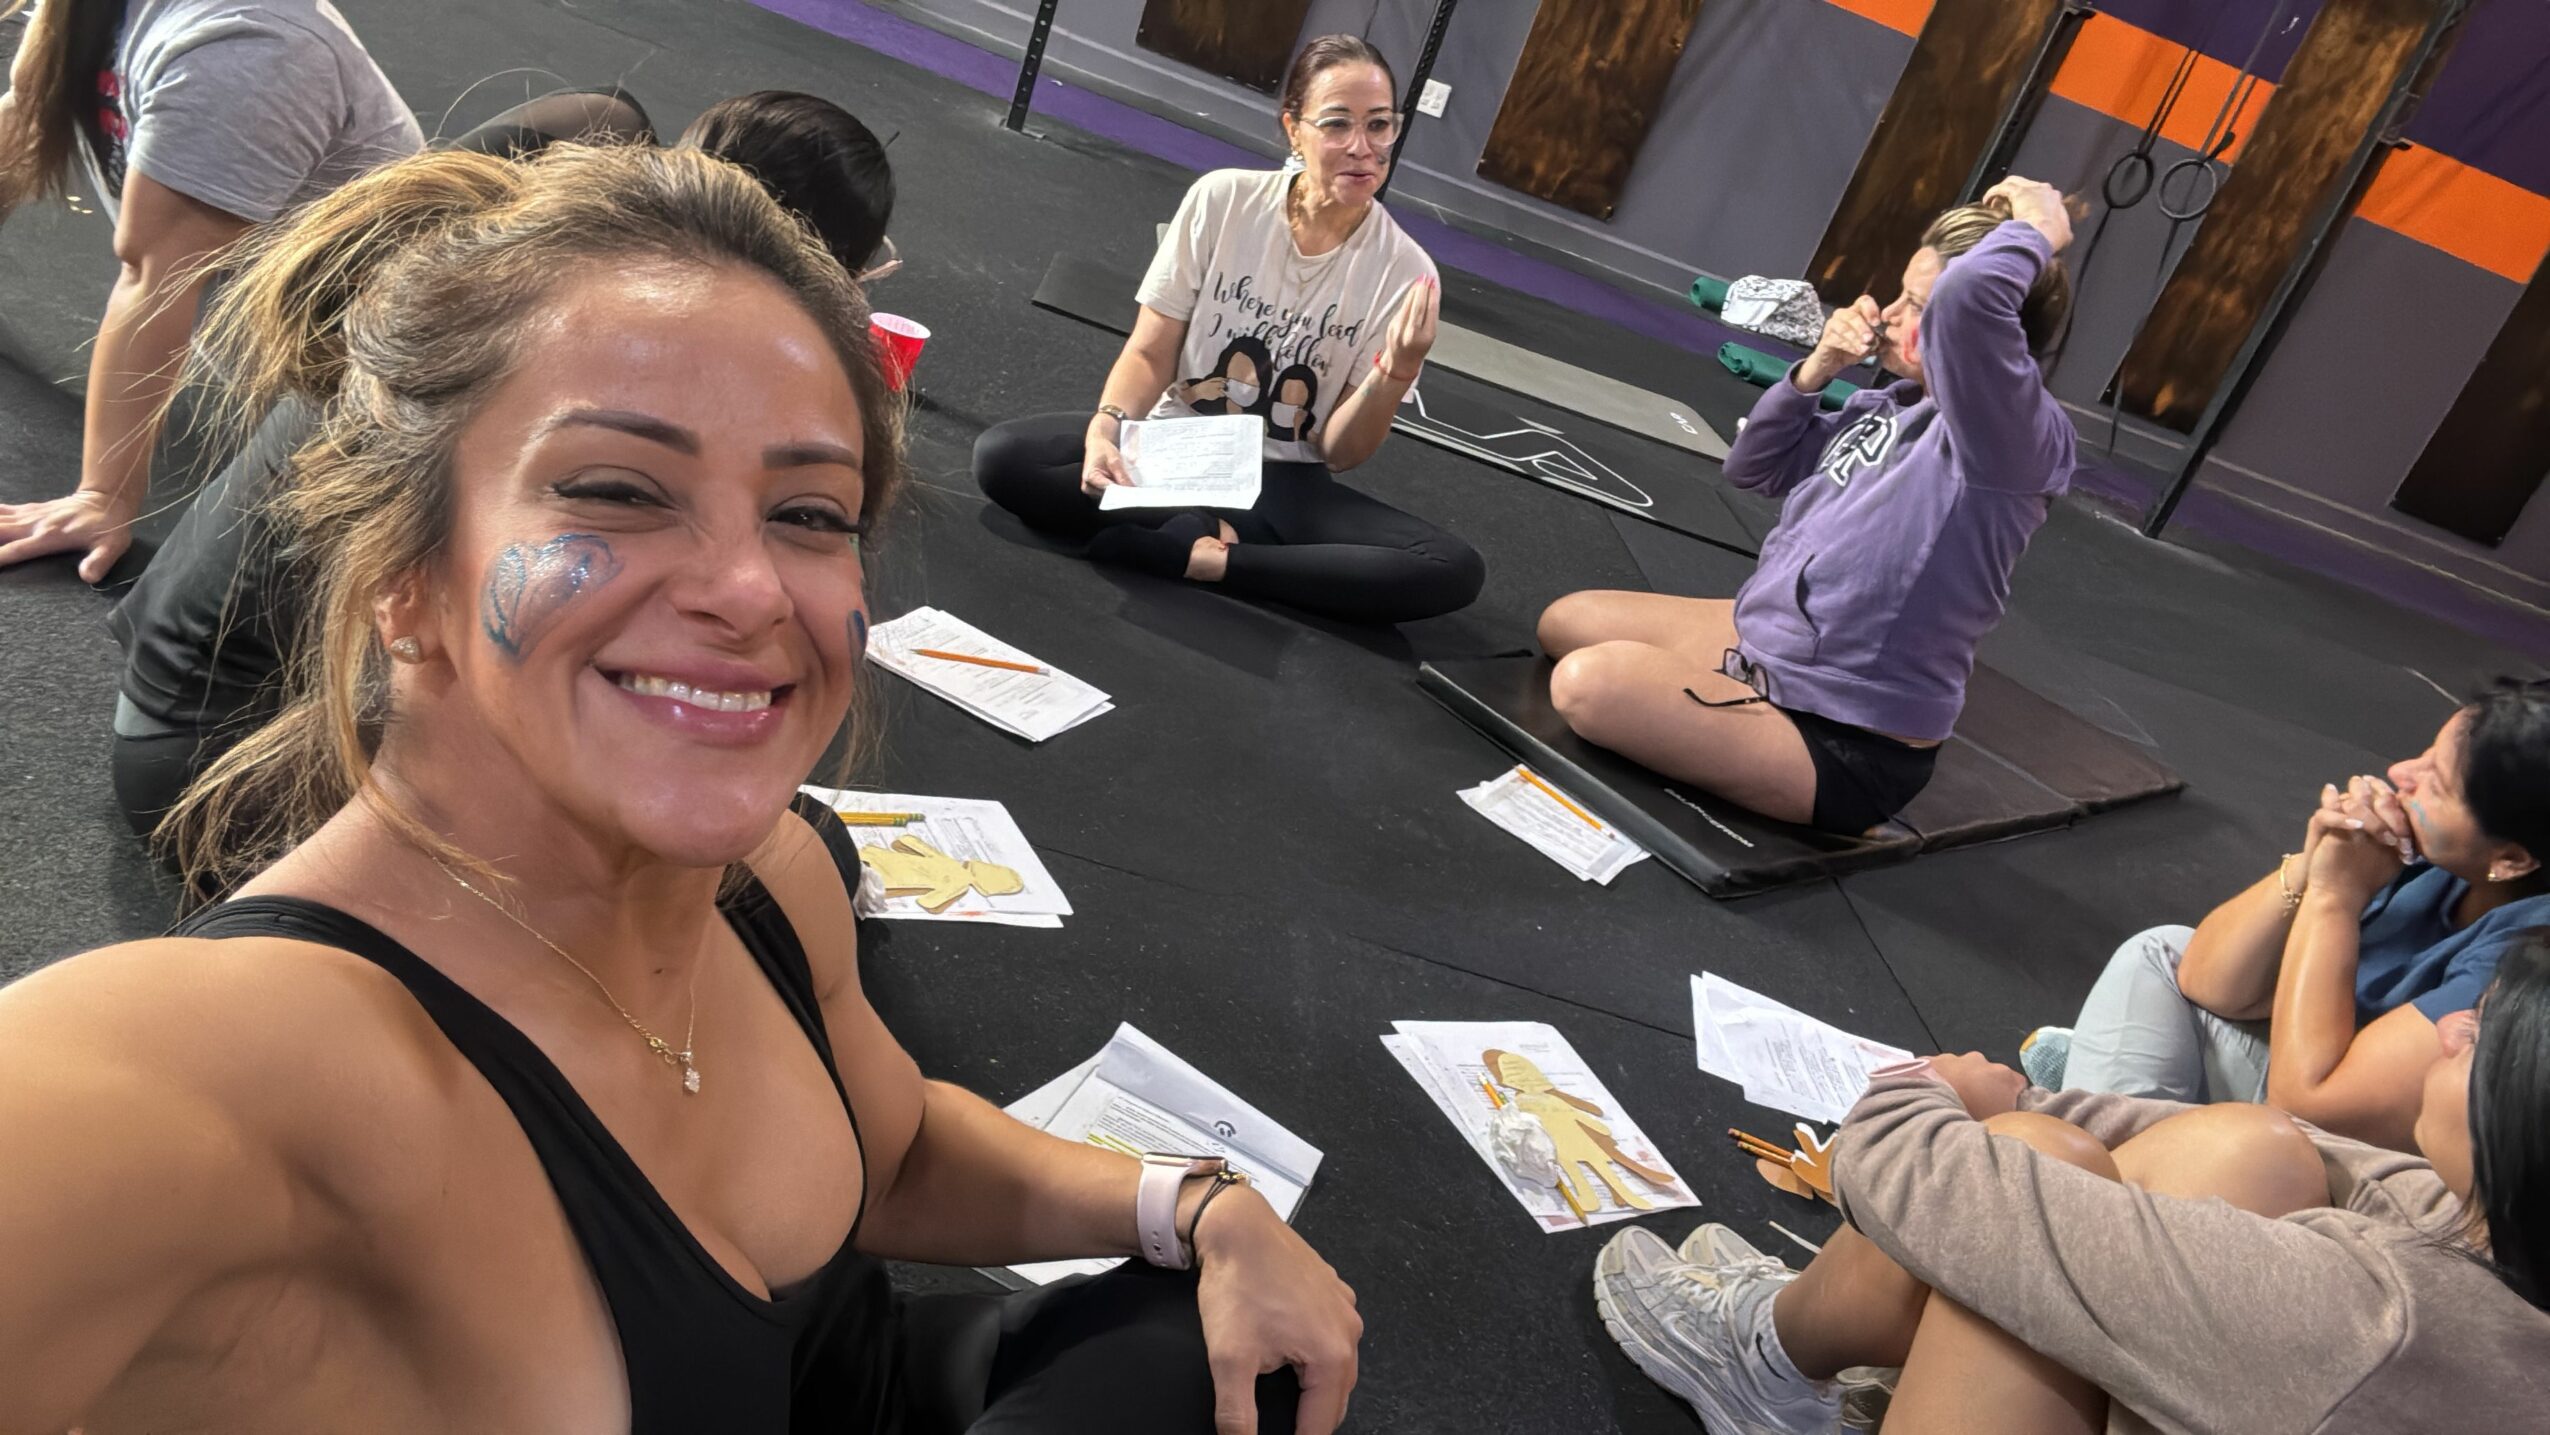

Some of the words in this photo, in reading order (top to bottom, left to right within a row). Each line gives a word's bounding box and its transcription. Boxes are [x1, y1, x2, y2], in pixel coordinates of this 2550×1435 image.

[1208, 312, 1223, 338] I
[1274, 331, 1333, 378] follow
[1213, 271, 1277, 320] Where
[1275, 307, 1315, 339] you
[1319, 303, 1367, 348] lead
